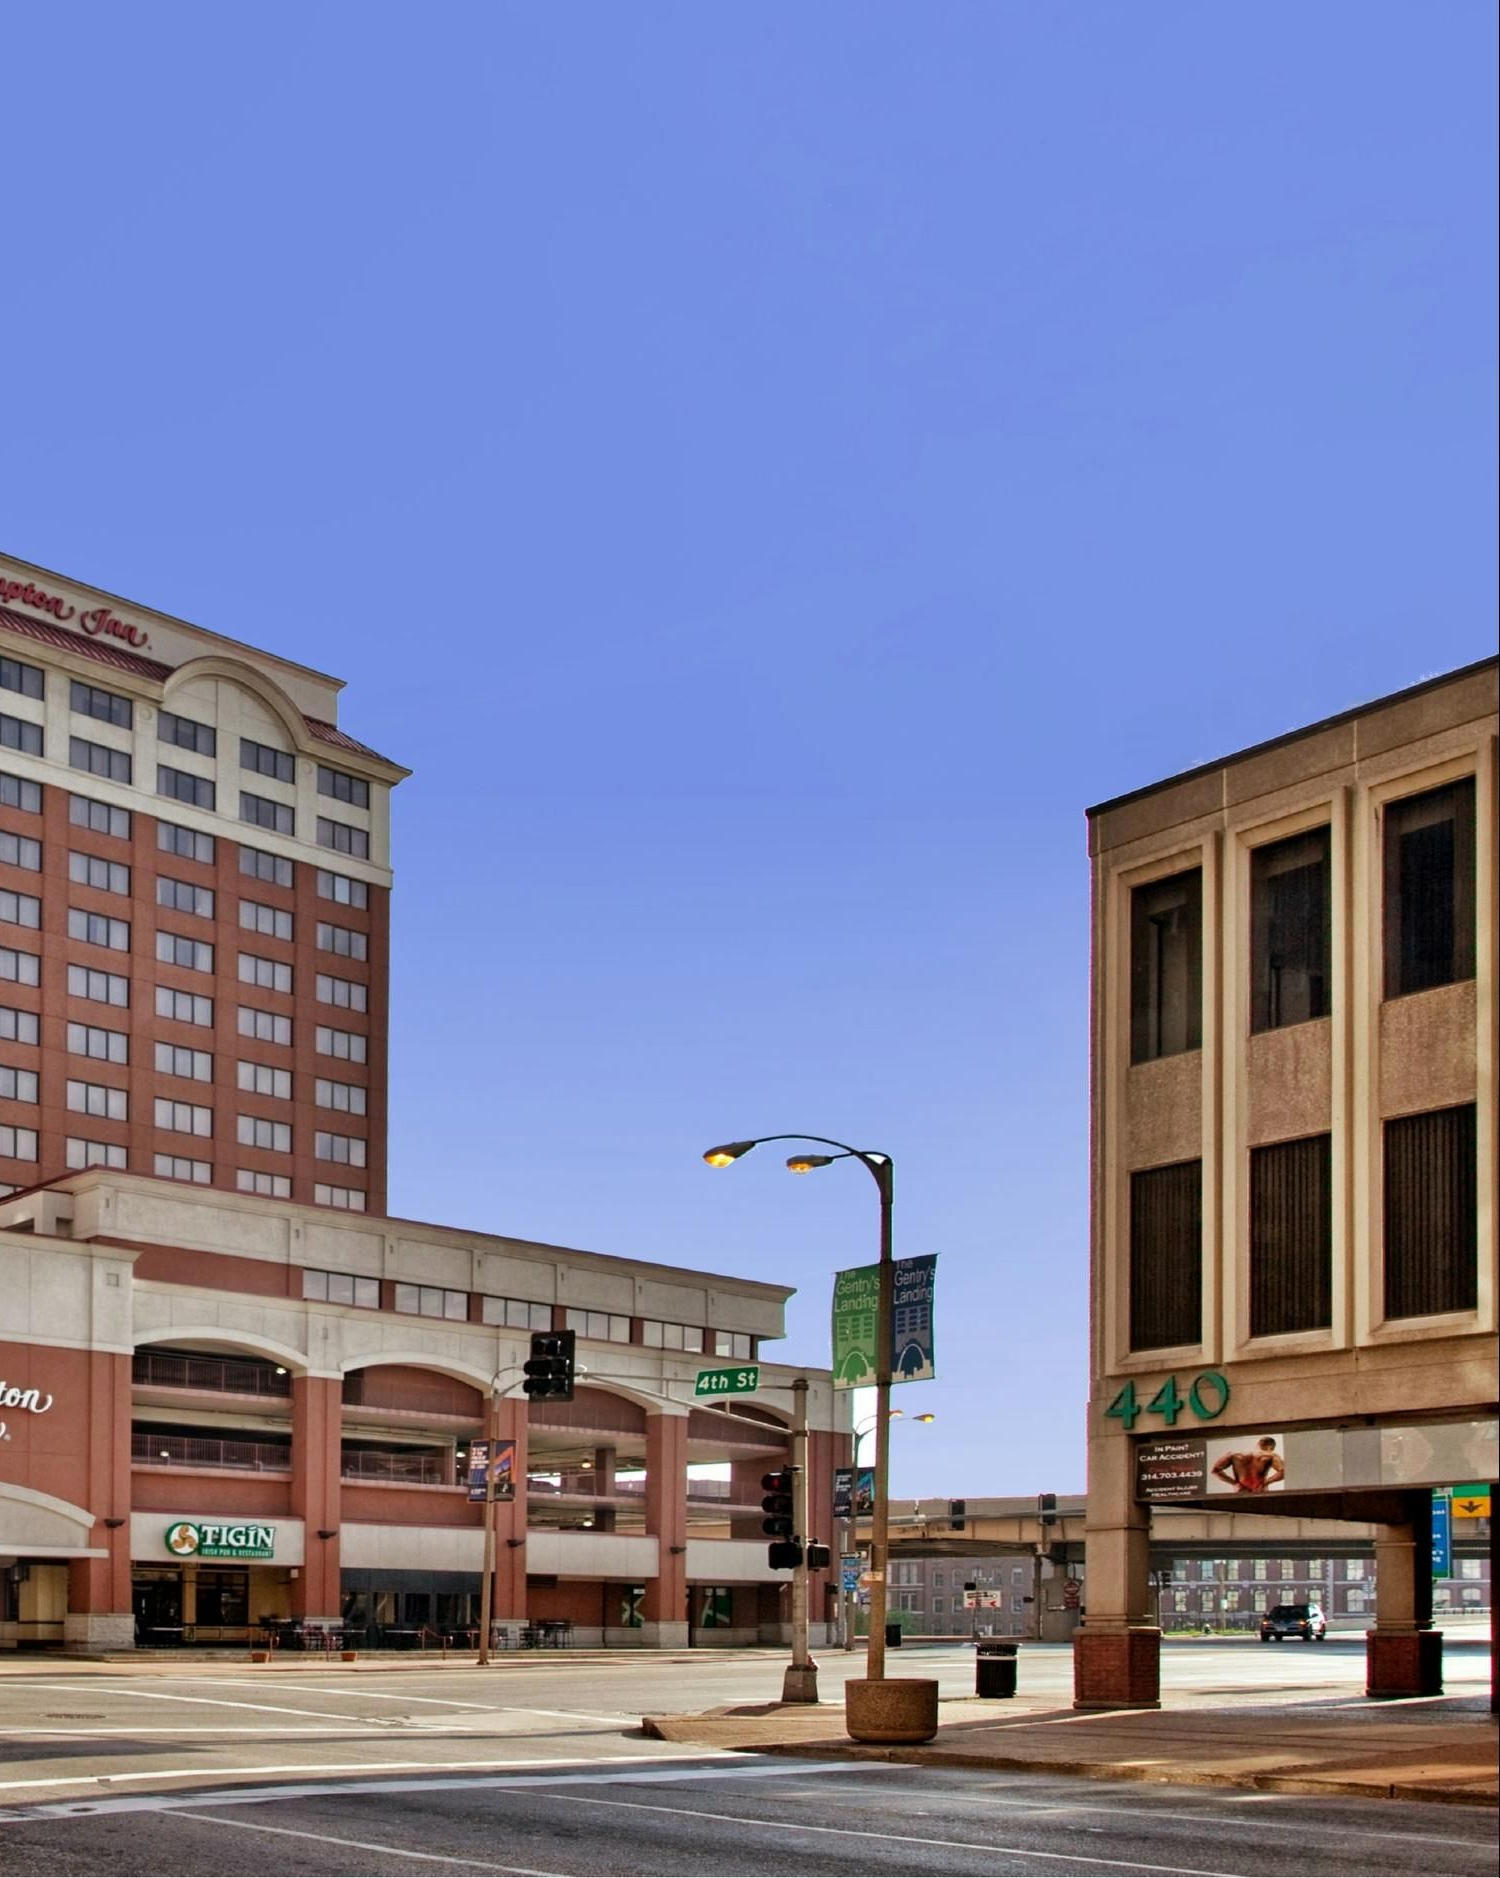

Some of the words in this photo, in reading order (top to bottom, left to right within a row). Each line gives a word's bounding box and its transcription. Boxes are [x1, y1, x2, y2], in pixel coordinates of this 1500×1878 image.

[80, 608, 149, 648] Inn
[836, 1275, 880, 1295] Gentry's
[894, 1265, 936, 1287] Gentry's
[834, 1295, 878, 1312] Landing
[894, 1286, 933, 1304] Landing
[698, 1375, 728, 1390] 4th
[736, 1372, 756, 1388] St
[1104, 1371, 1230, 1430] 440
